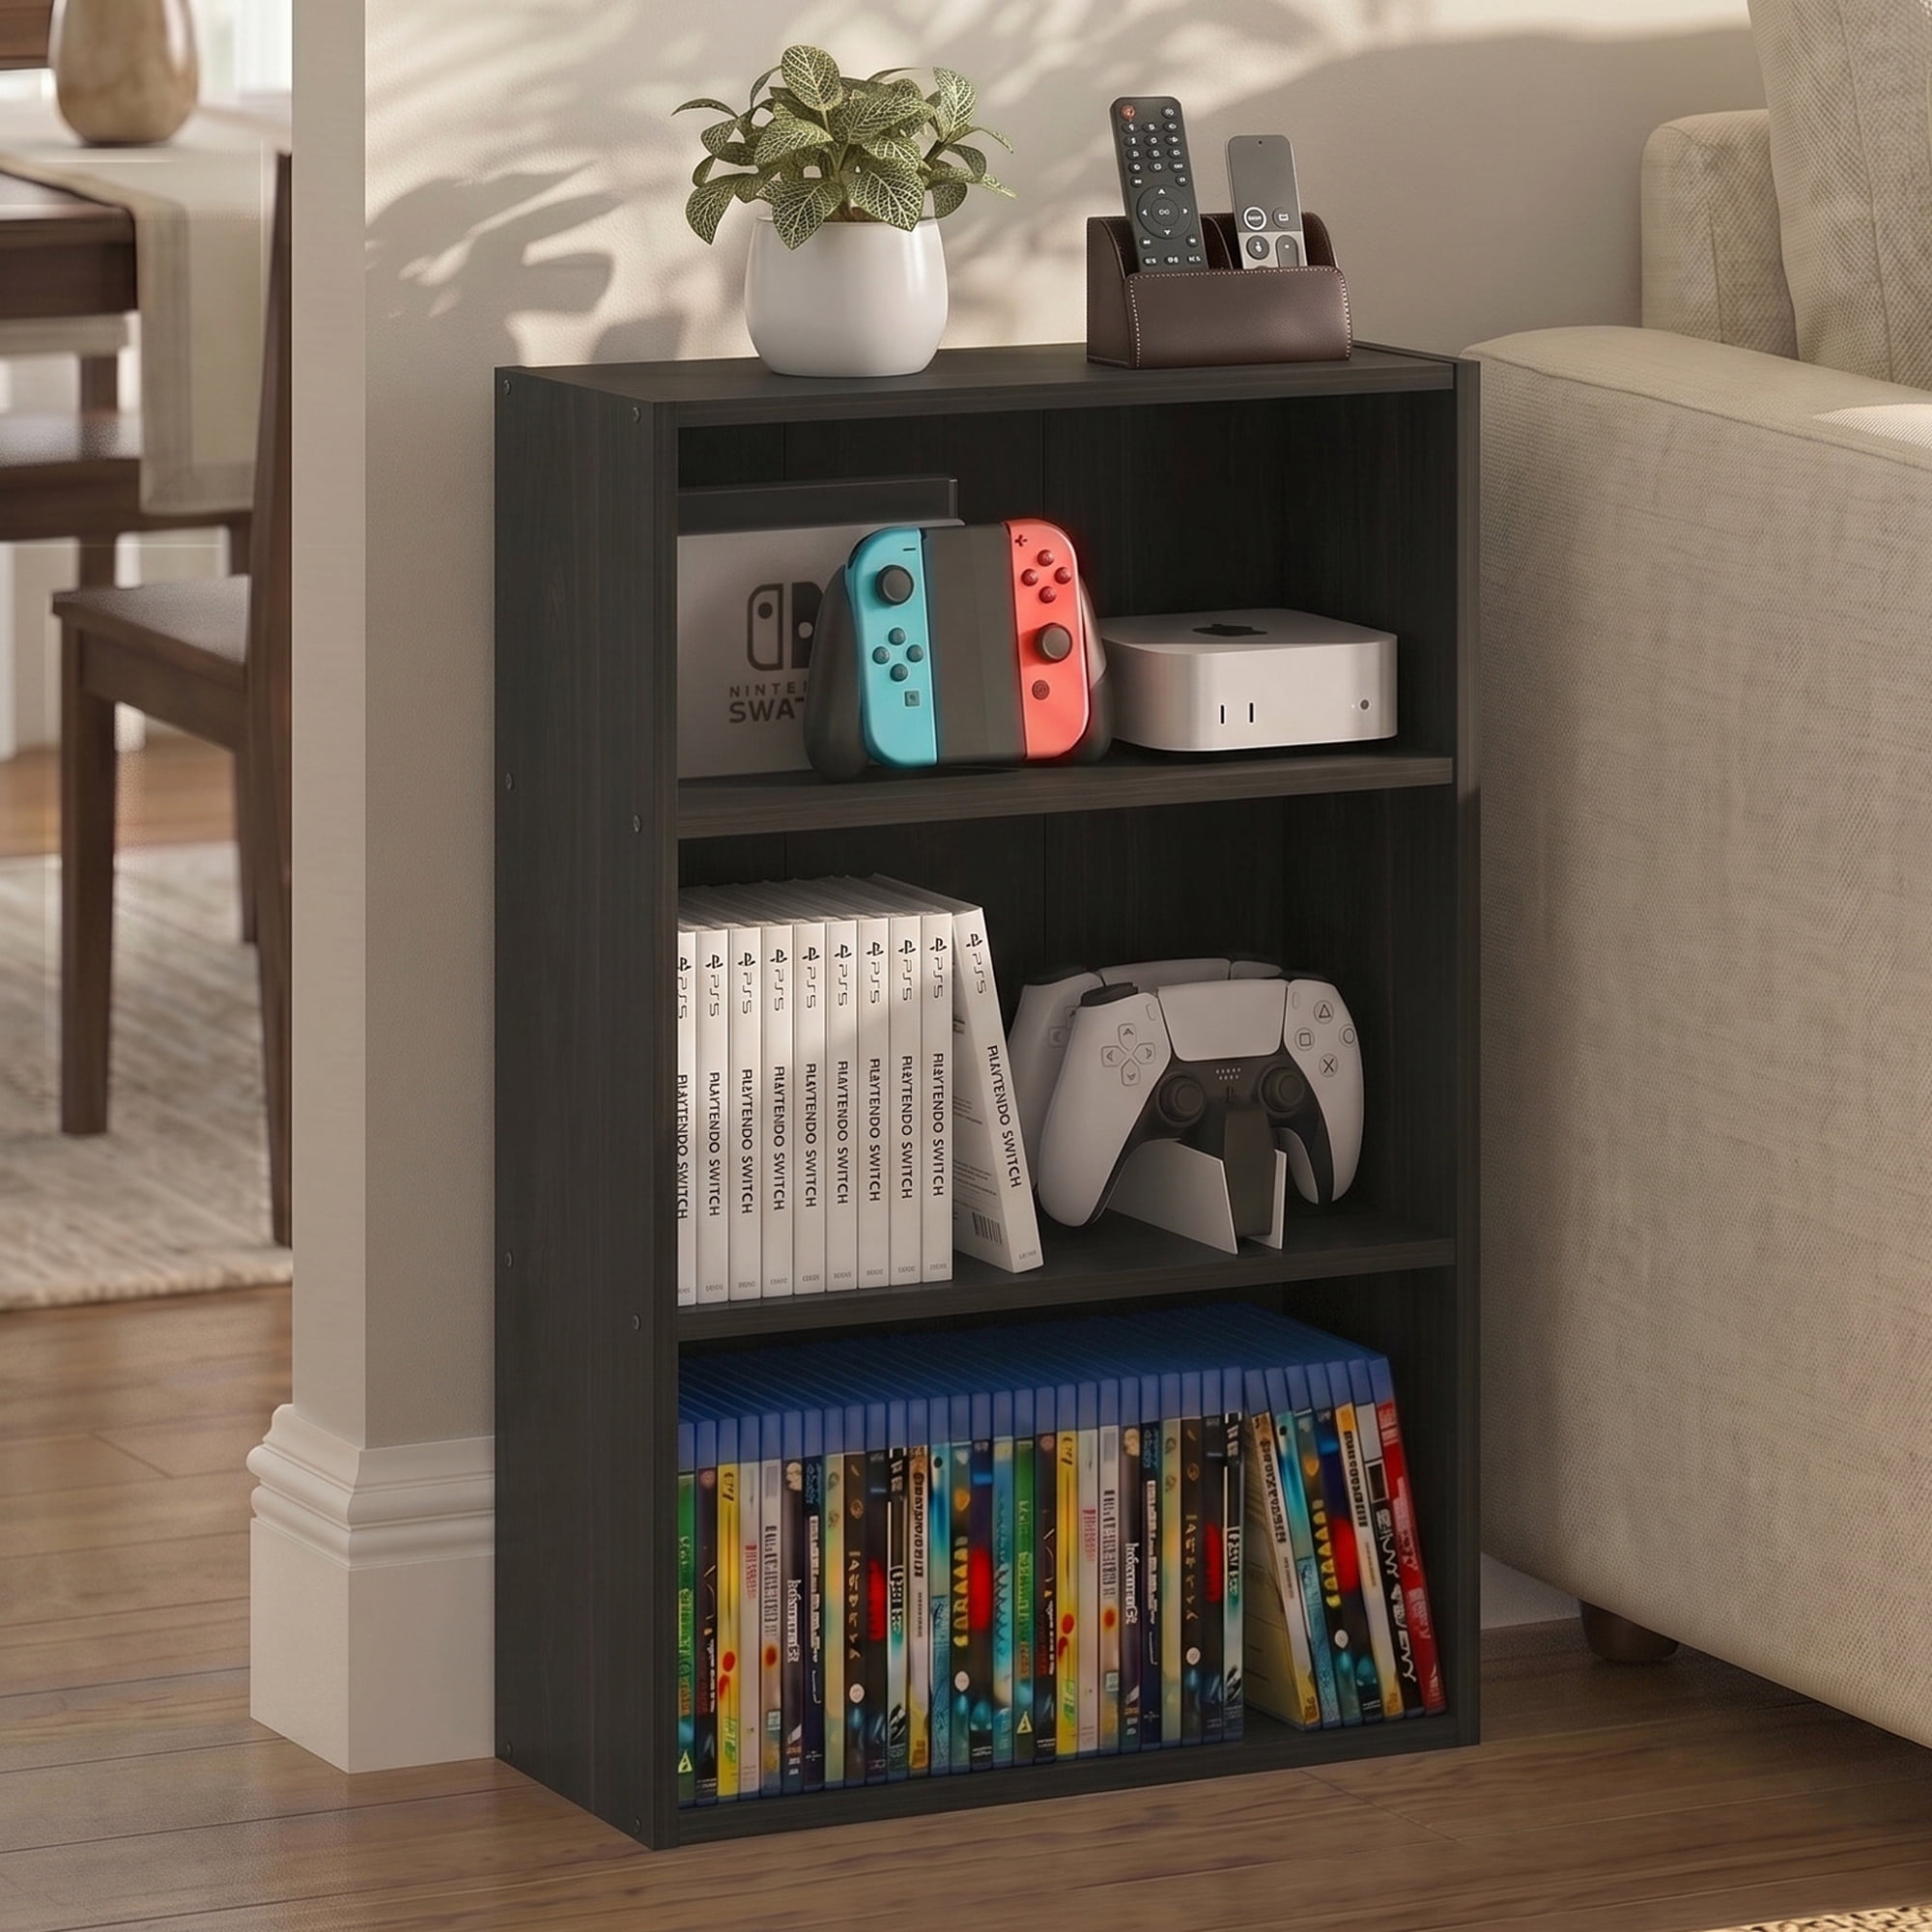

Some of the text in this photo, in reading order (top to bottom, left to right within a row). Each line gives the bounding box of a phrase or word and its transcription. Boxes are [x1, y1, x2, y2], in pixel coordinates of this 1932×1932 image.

[708, 1158, 720, 1217] SWITCH
[742, 1155, 753, 1214] SWITCH
[774, 1152, 785, 1210] SWITCH
[806, 1150, 816, 1208] SWITCH
[838, 1147, 848, 1204] SWITCH
[869, 1144, 880, 1202] SWITCH
[901, 1141, 912, 1199] SWITCH
[933, 1139, 944, 1196] SWITCH
[1002, 1129, 1022, 1188] SWITCH
[678, 1161, 688, 1219] SWITCH
